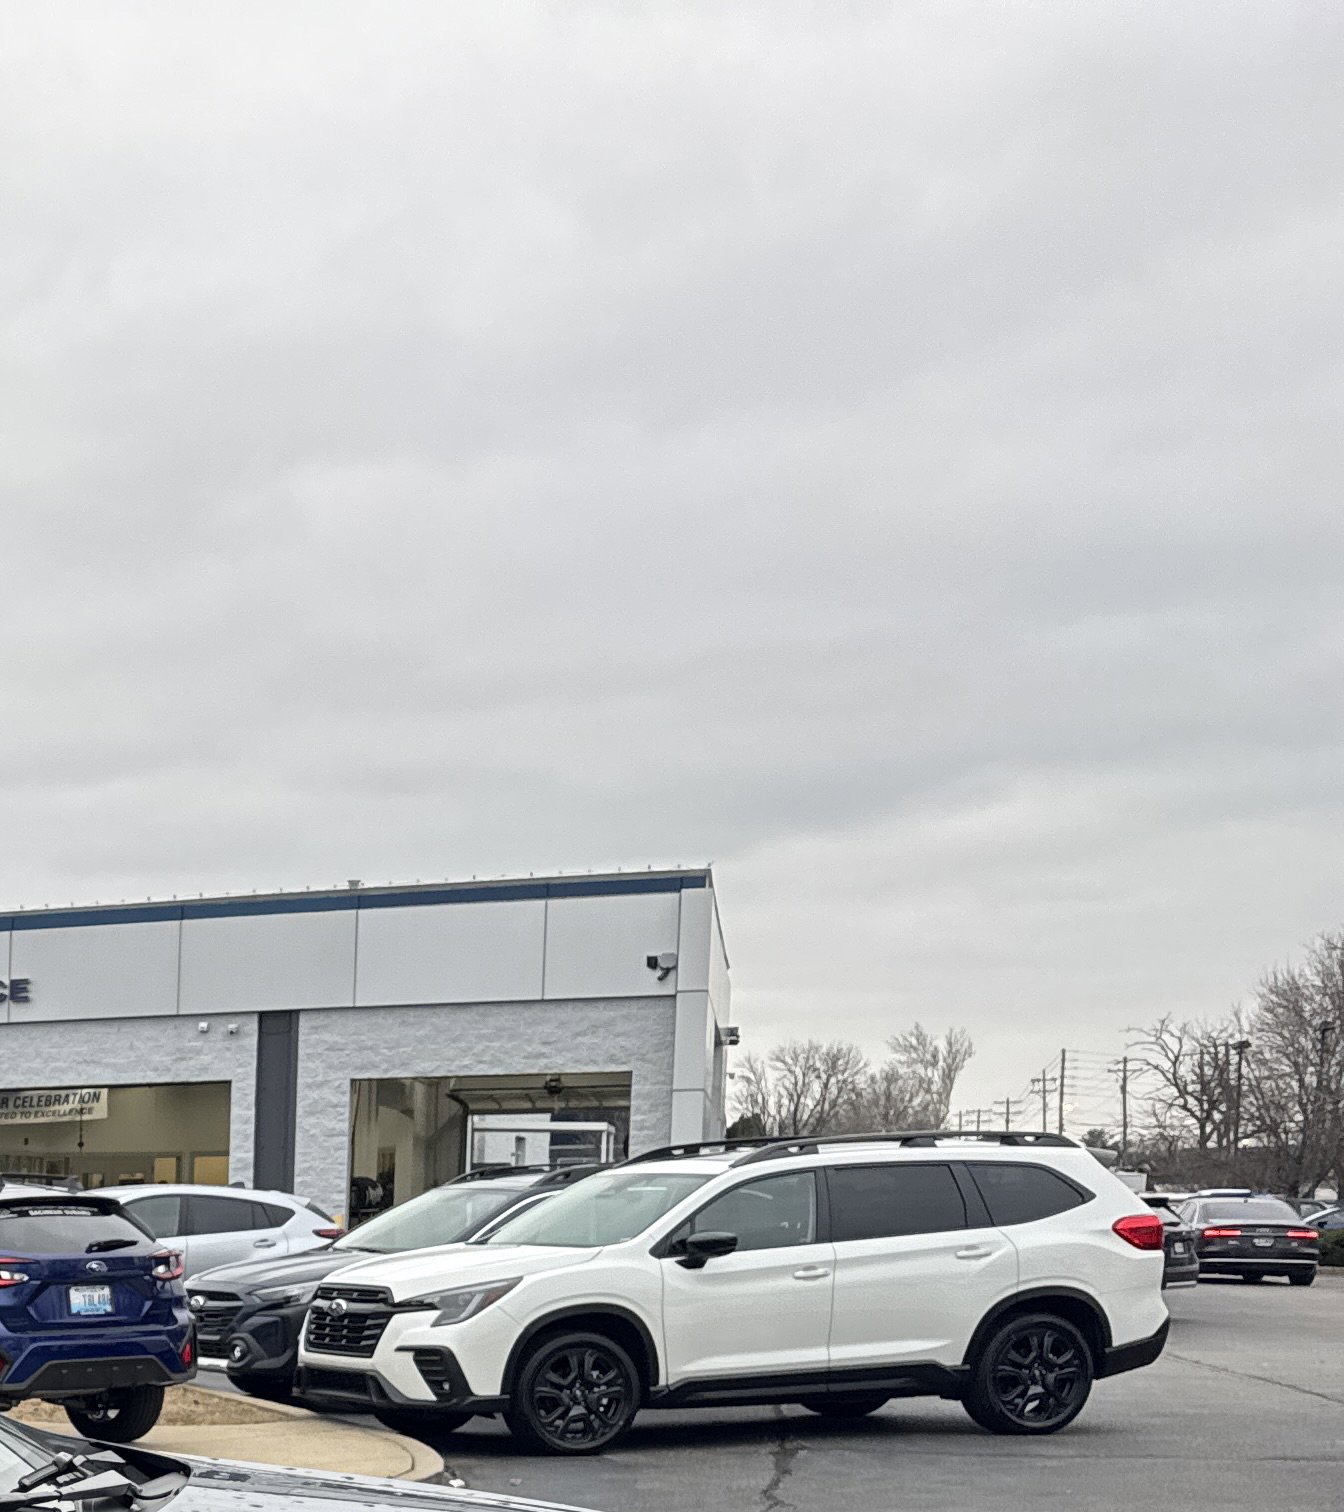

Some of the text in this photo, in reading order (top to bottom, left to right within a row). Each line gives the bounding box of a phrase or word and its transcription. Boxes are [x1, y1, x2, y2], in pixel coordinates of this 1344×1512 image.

[13, 1090, 102, 1110] CELEBRATION
[20, 1110, 32, 1120] TO
[33, 1106, 95, 1119] EXCELLENCE
